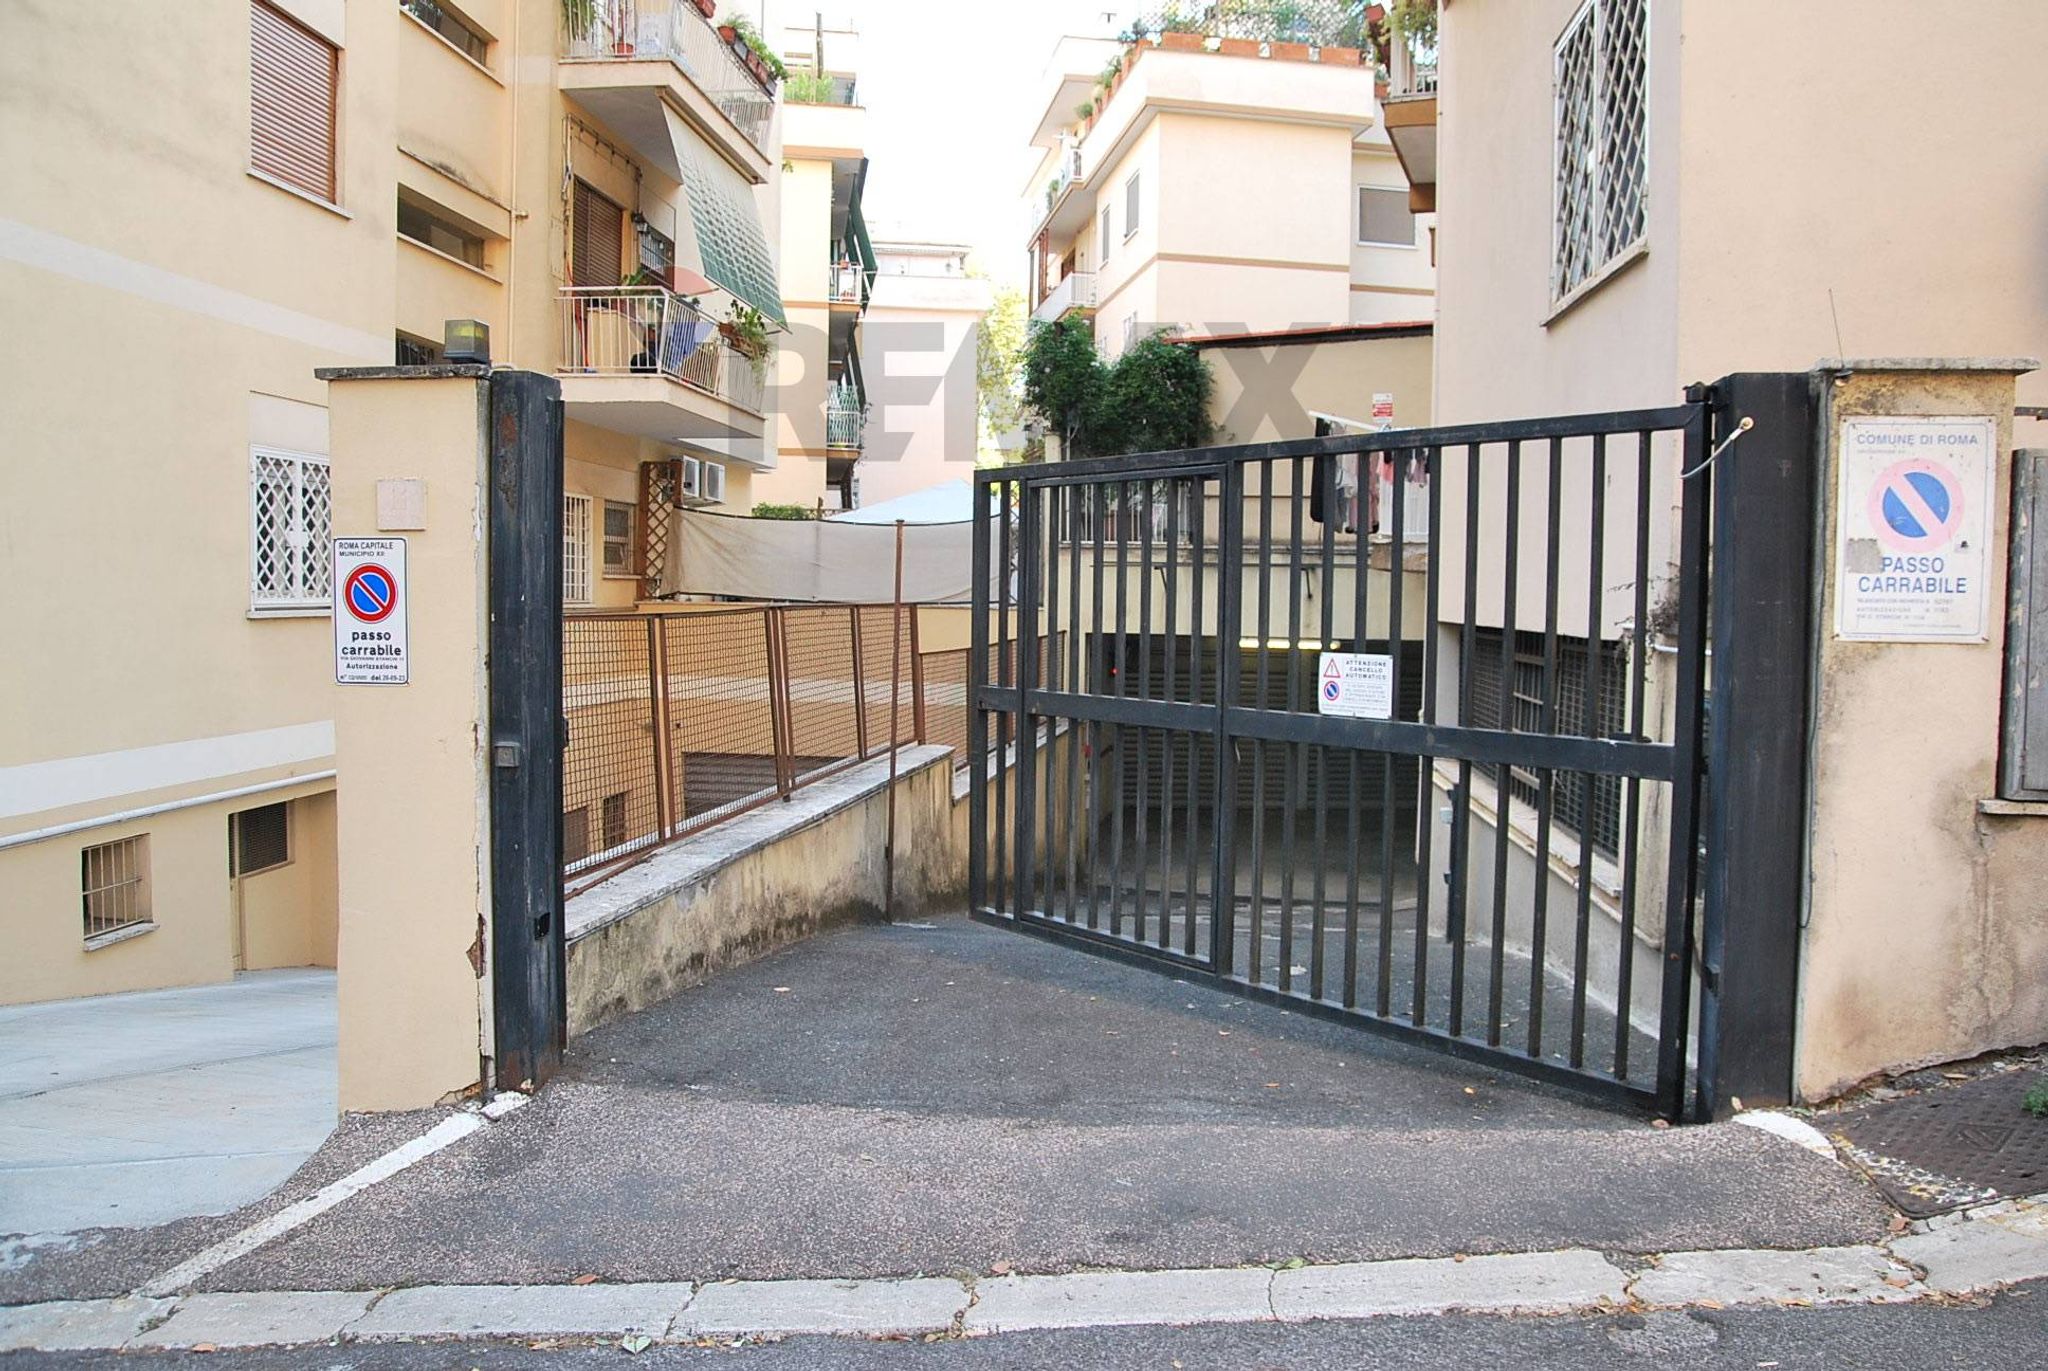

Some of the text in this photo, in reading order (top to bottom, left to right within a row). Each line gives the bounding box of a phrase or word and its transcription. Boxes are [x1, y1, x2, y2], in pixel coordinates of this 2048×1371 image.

[1857, 434, 1978, 445] COMUNE DI ROMA
[1882, 557, 1944, 573] PASSO
[1858, 576, 1967, 593] CARRABILE
[352, 631, 391, 642] passo
[342, 645, 402, 655] carrabile
